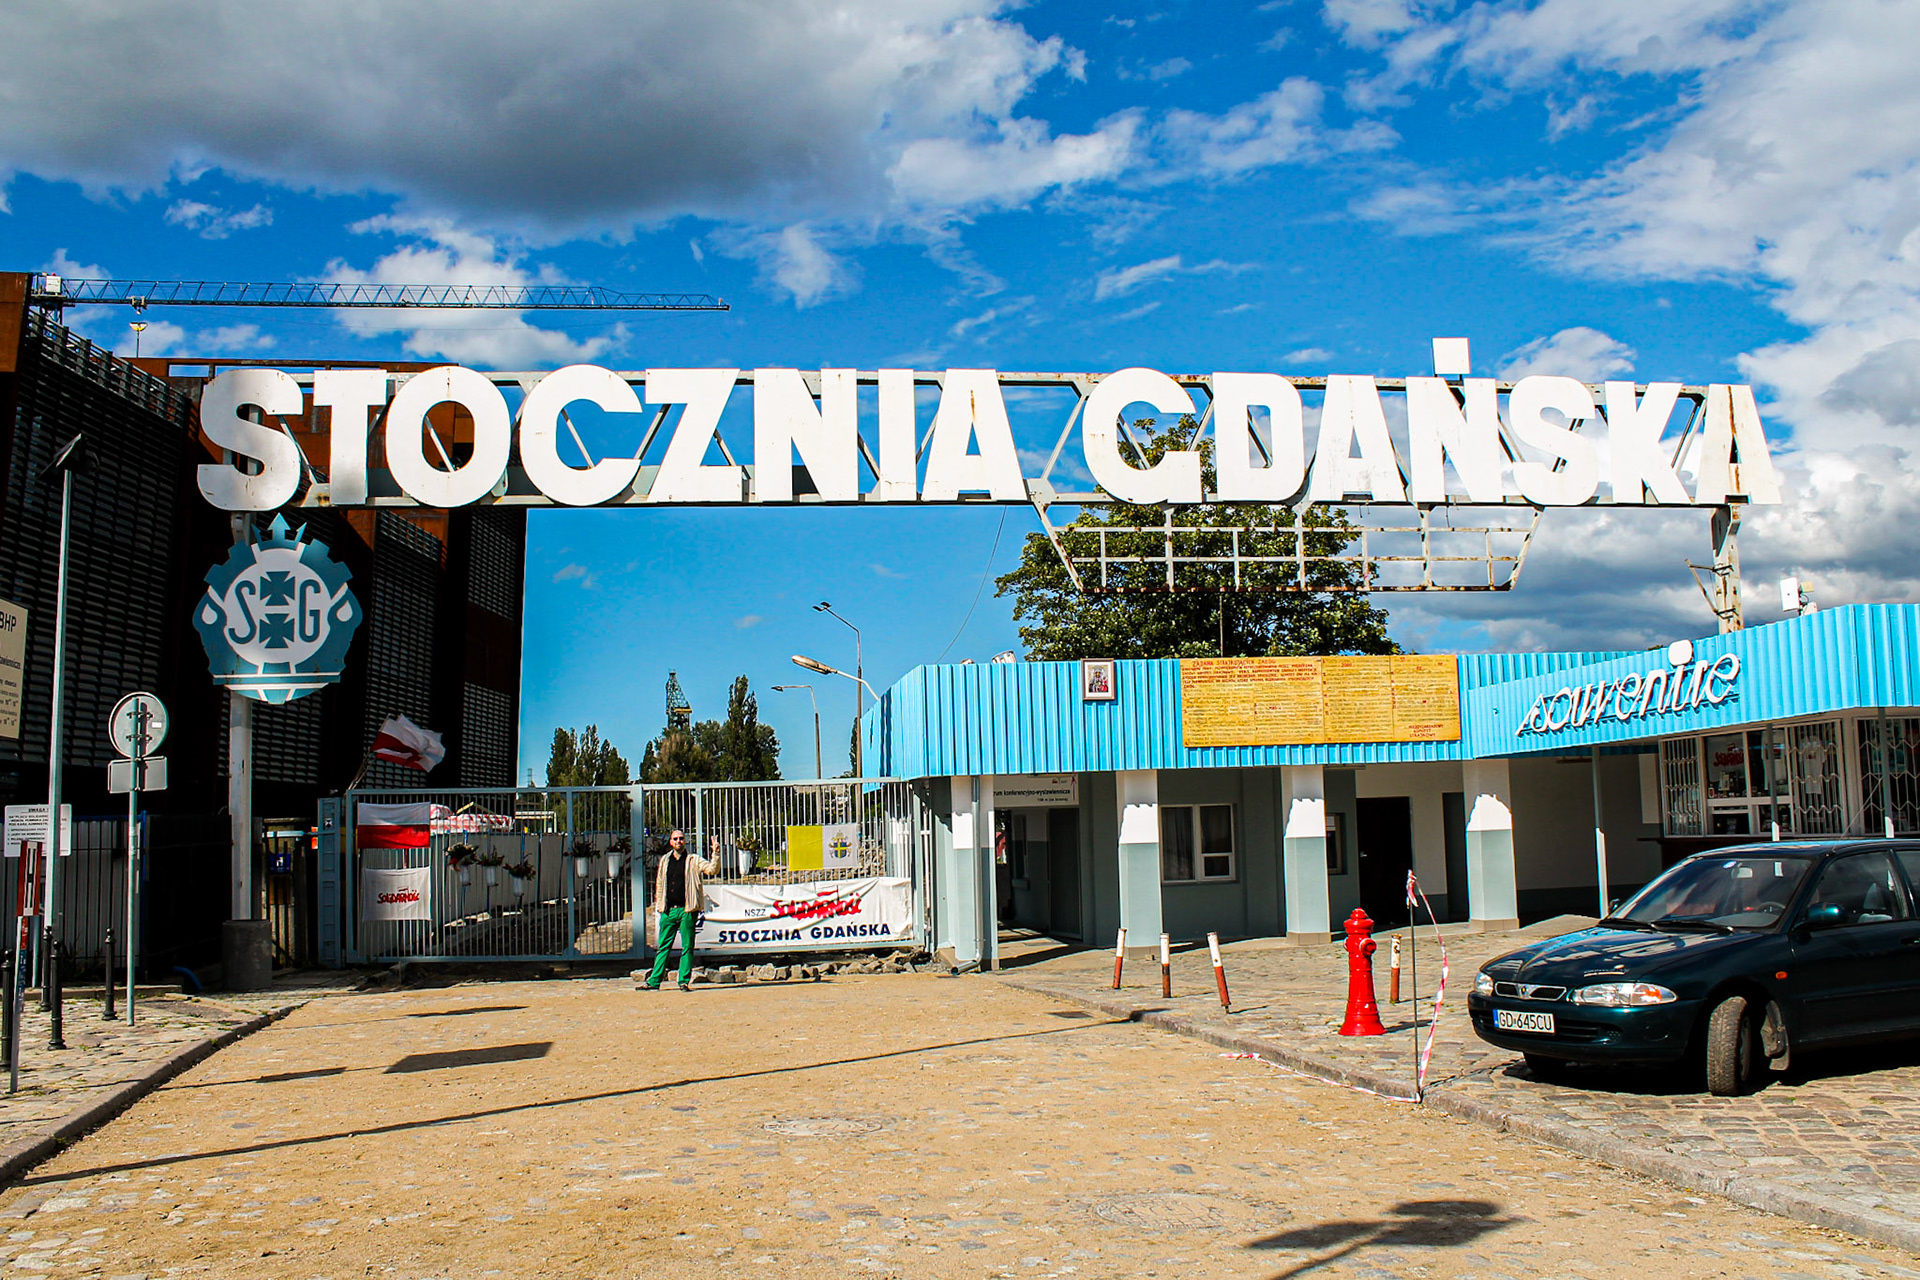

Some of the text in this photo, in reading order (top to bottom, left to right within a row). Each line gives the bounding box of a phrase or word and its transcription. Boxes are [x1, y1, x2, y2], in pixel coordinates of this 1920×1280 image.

[197, 337, 1781, 510] STOCZNIA GDAŃSKA
[745, 909, 766, 917] NSZZ
[719, 921, 890, 943] STOCZNIA GDAŃSKA
[1499, 1012, 1552, 1030] GD 645CU
